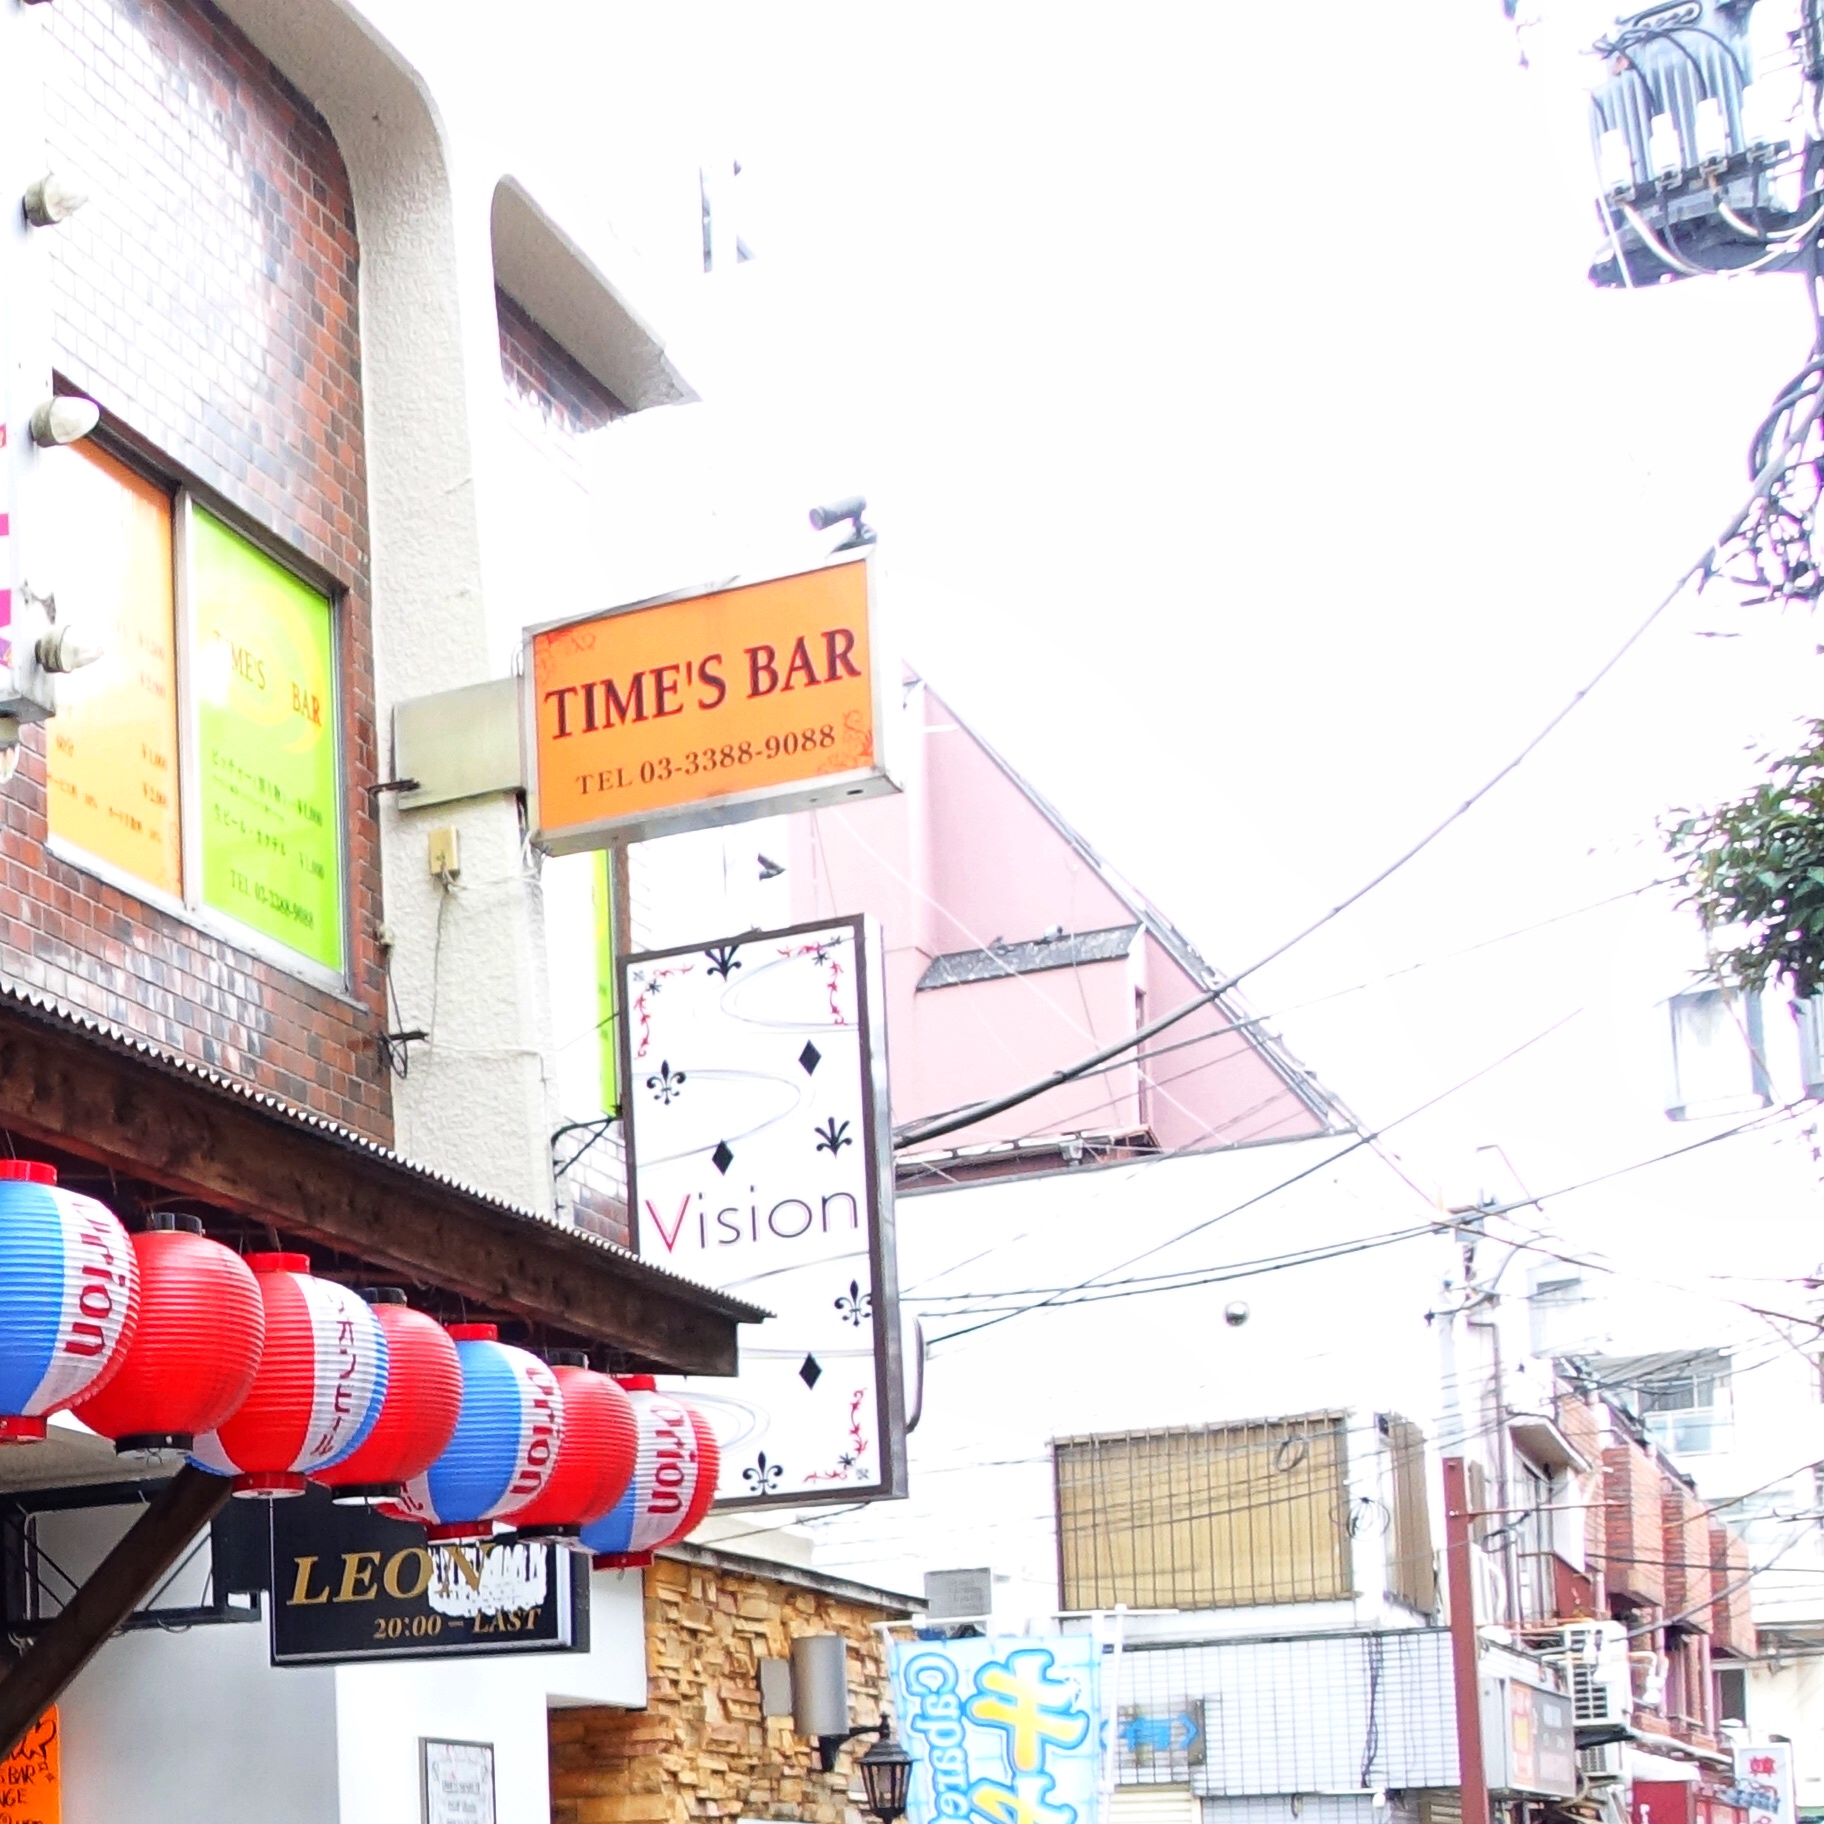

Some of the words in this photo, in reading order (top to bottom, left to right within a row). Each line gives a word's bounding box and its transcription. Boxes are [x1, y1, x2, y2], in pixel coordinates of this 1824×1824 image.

[291, 681, 323, 728] BAR
[545, 653, 727, 741] TIME'S
[744, 627, 861, 700] BAR
[575, 767, 633, 795] TEL
[639, 723, 836, 785] 03-3388-9088
[643, 1184, 860, 1254] Vision
[372, 1615, 441, 1640] 20:00
[472, 1608, 542, 1635] LAST
